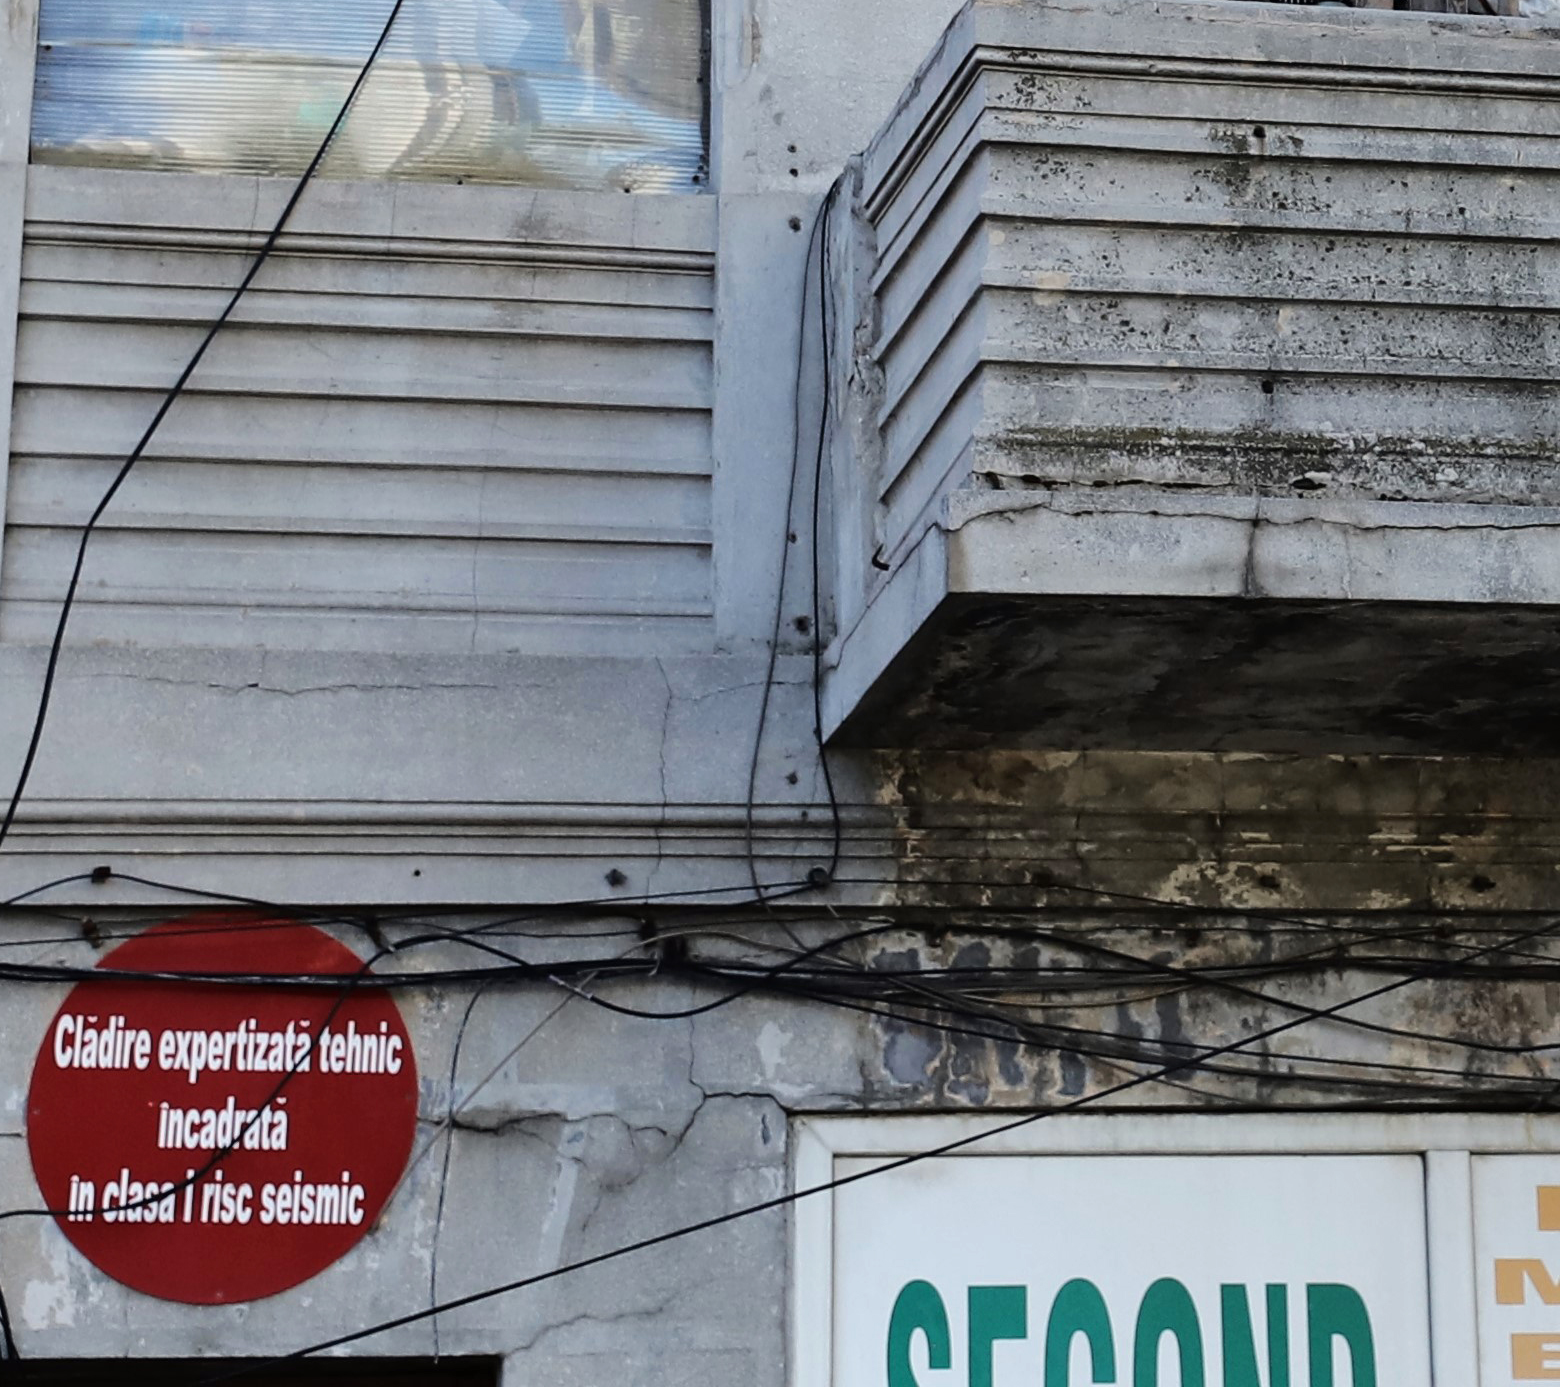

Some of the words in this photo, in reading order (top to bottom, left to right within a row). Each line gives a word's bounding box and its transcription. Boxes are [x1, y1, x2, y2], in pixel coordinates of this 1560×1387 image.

[53, 1014, 152, 1069] Clădire
[158, 1018, 312, 1084] expertizată
[319, 1020, 404, 1075] tehnic
[157, 1096, 288, 1151] încadrată
[67, 1174, 95, 1222] în
[101, 1167, 176, 1223] clasa
[200, 1170, 253, 1224] risc
[259, 1170, 365, 1226] seismic
